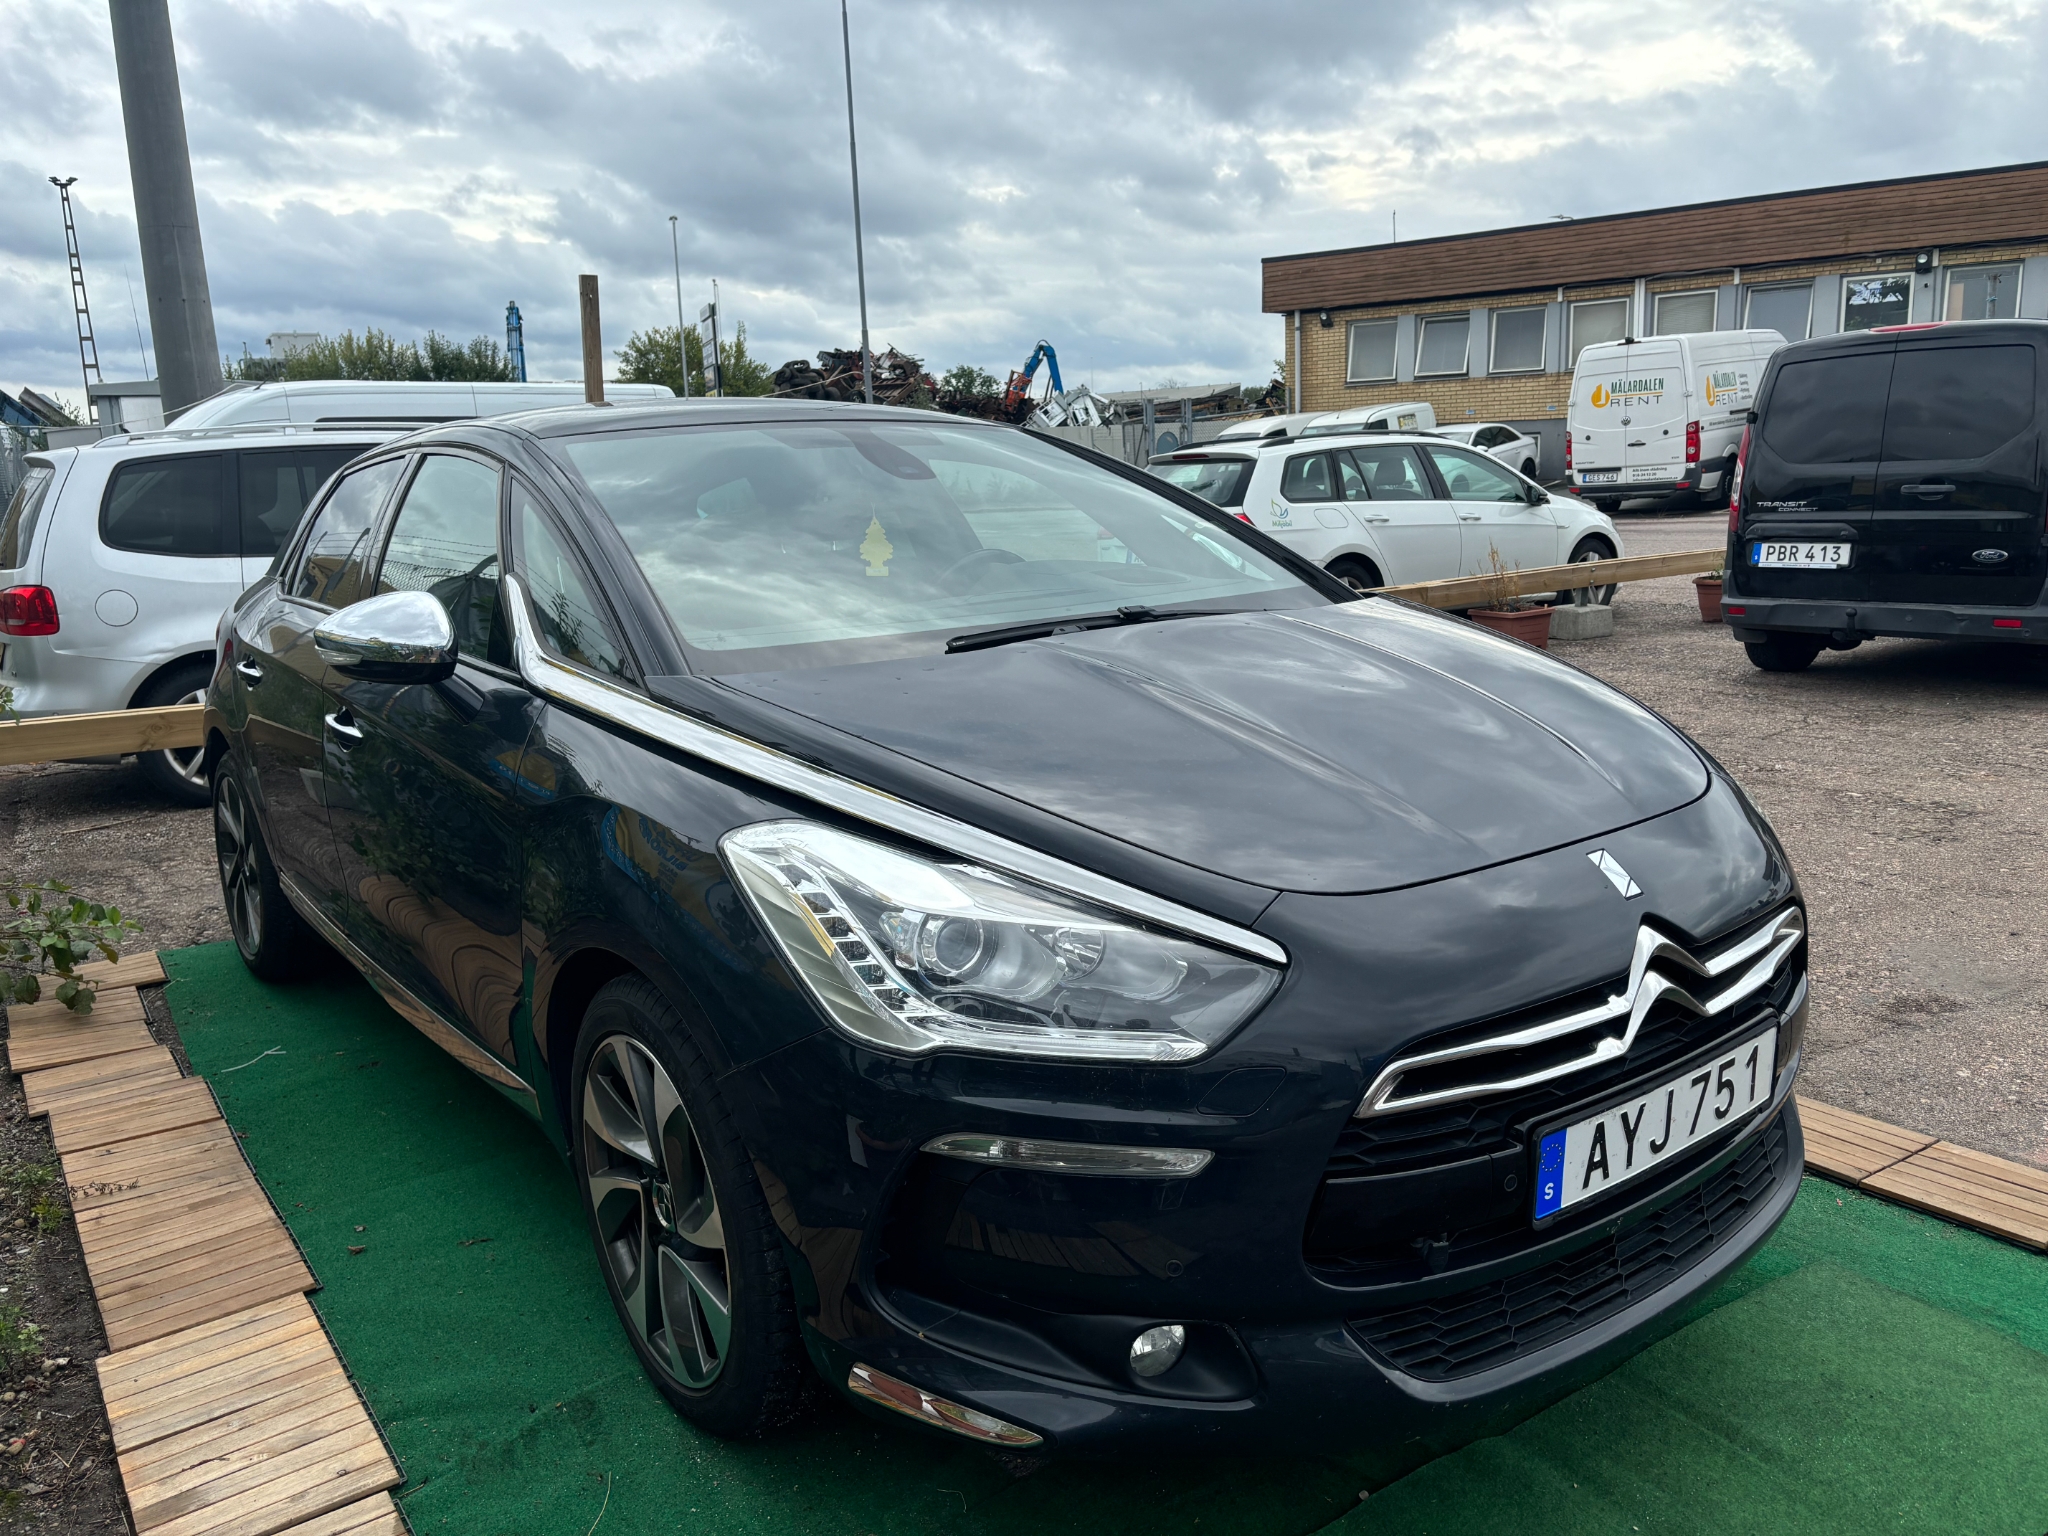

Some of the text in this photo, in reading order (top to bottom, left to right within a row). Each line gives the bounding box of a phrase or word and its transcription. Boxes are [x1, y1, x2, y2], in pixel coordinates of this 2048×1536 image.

[1611, 378, 1664, 394] MÄLARDALEN
[1611, 395, 1663, 408] RENT
[1715, 392, 1738, 406] RENT
[1601, 473, 1615, 481] 746
[1765, 545, 1799, 562] PBR
[1804, 545, 1842, 562] 413
[1582, 1042, 1760, 1191] AYJ 751
[1543, 1182, 1555, 1201] S
